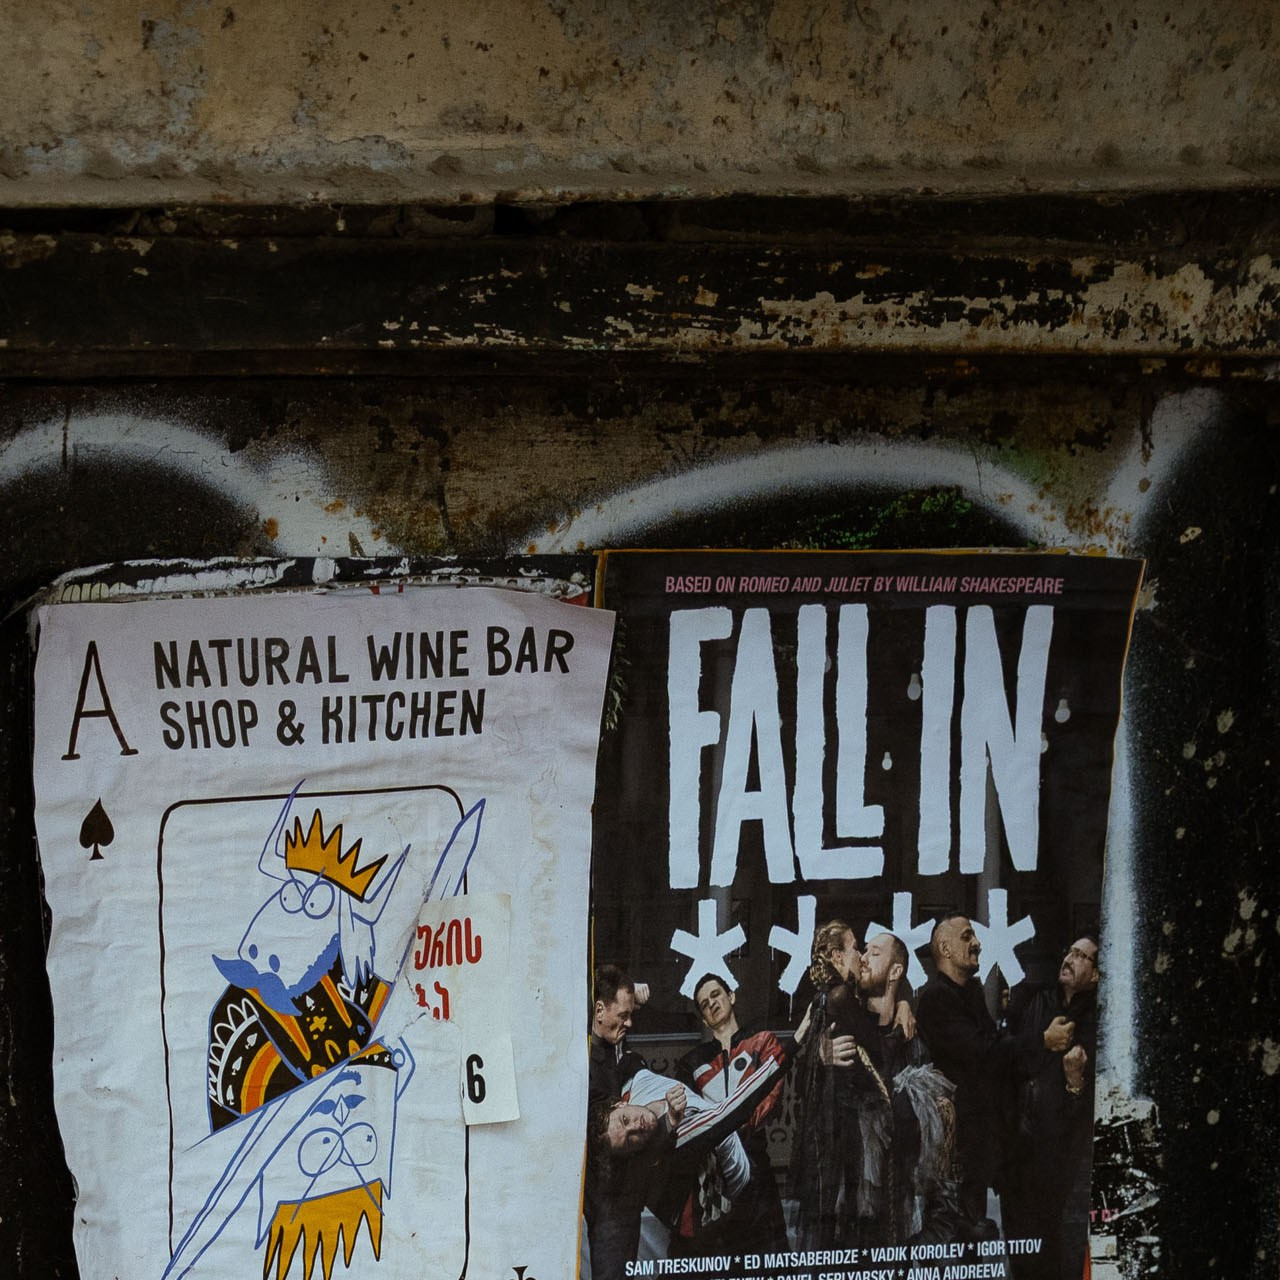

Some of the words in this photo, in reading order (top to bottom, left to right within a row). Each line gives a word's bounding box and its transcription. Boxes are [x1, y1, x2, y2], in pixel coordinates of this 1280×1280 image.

[665, 576, 712, 593] BASED
[716, 576, 736, 593] ON
[738, 576, 790, 593] ROMEO
[791, 576, 822, 593] AND
[824, 576, 872, 593] JULIET
[873, 576, 894, 593] BY
[896, 576, 957, 594] WILLIAM
[959, 576, 1064, 595] SHAKESPEARE
[153, 634, 350, 690] NATURAL
[367, 629, 470, 682] WINE
[486, 625, 576, 677] BAR
[61, 640, 139, 760] A
[158, 697, 259, 750] SHOP
[276, 697, 306, 746] &
[321, 687, 487, 745] KITCHEN
[668, 603, 884, 889] FALL
[918, 604, 1054, 876] IN
[625, 1259, 655, 1277] SAM
[657, 1255, 732, 1275] TRESKUNOV
[743, 1254, 761, 1270] ED
[763, 1249, 859, 1270] MATSABERIDZE
[870, 1245, 908, 1264] VADIK
[910, 1242, 966, 1261] KOROLEV
[976, 1240, 1006, 1257] IGOR
[1008, 1238, 1043, 1256] TITOV
